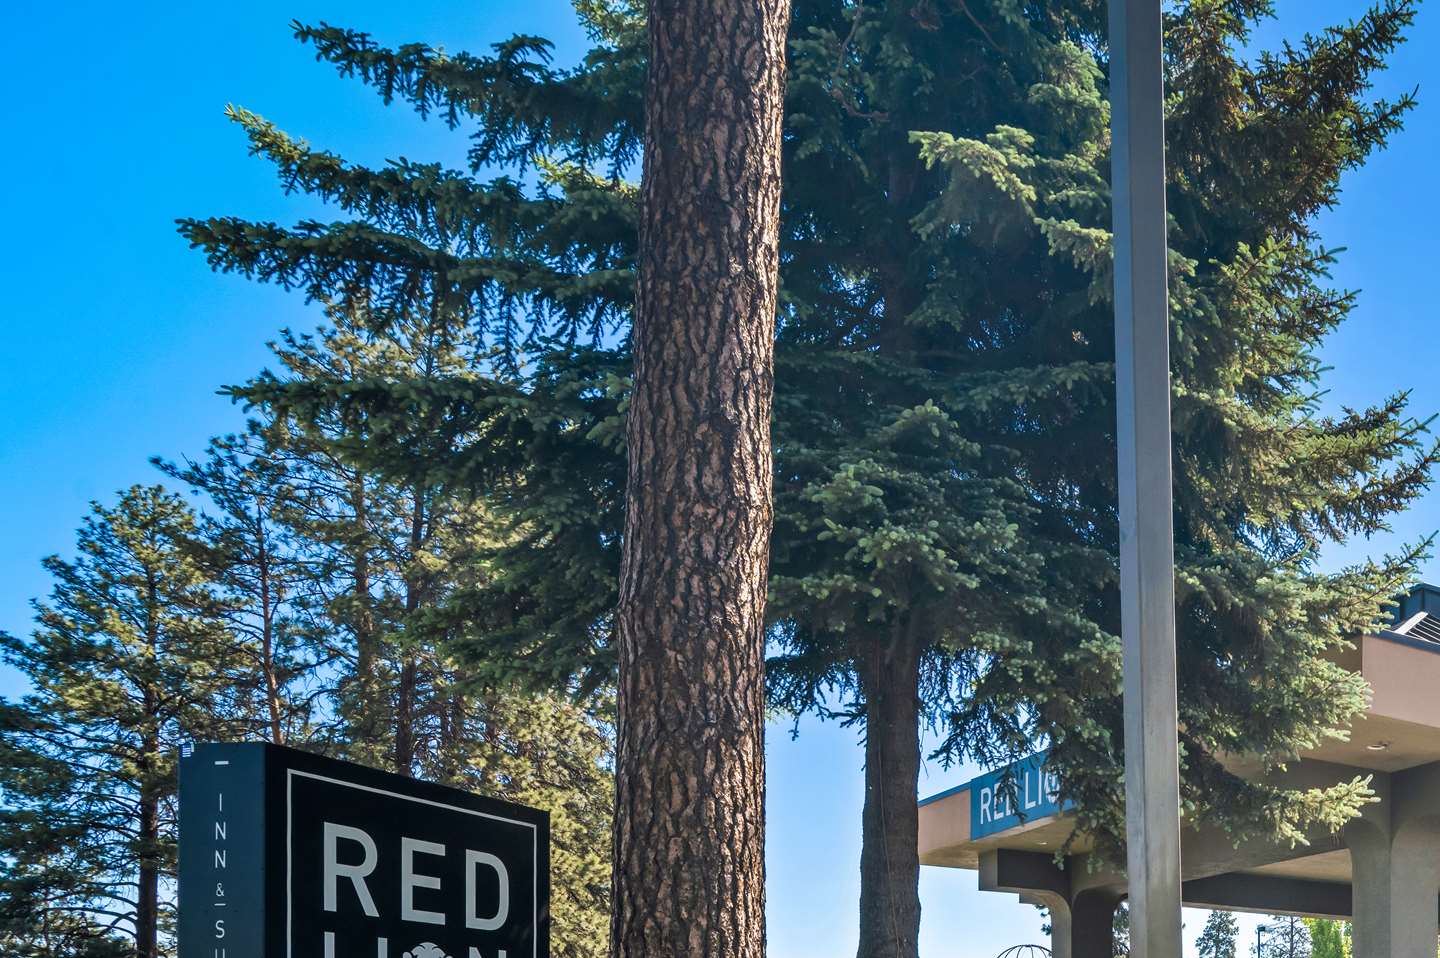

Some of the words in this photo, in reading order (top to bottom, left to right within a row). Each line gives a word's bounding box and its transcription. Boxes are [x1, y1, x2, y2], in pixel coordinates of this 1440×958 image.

[214, 793, 227, 869] INN
[214, 882, 226, 906] &
[322, 821, 512, 931] RED
